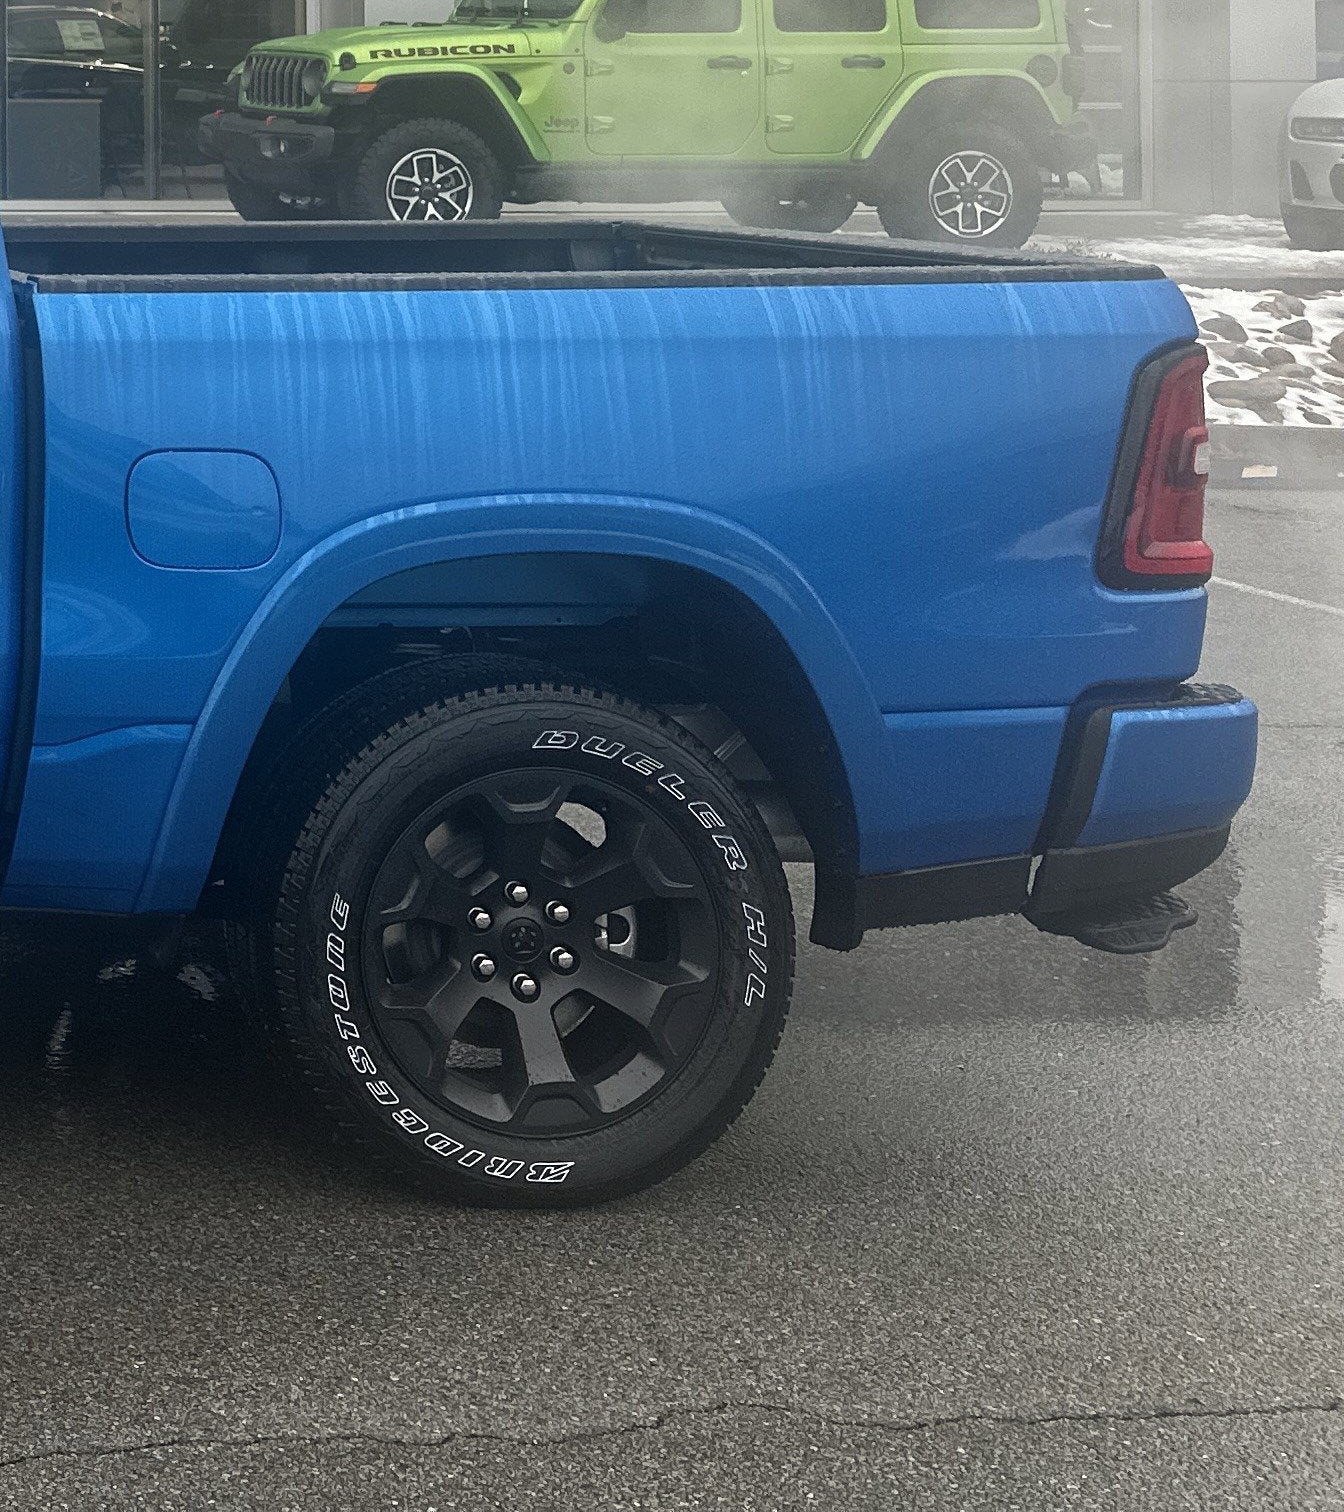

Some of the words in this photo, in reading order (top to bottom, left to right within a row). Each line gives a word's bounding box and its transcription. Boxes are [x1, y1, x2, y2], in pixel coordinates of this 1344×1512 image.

[369, 44, 516, 59] RUBICON
[531, 728, 749, 873] DUELER
[741, 901, 769, 1007] H/L
[326, 892, 576, 1184] BRIDGESTONE
